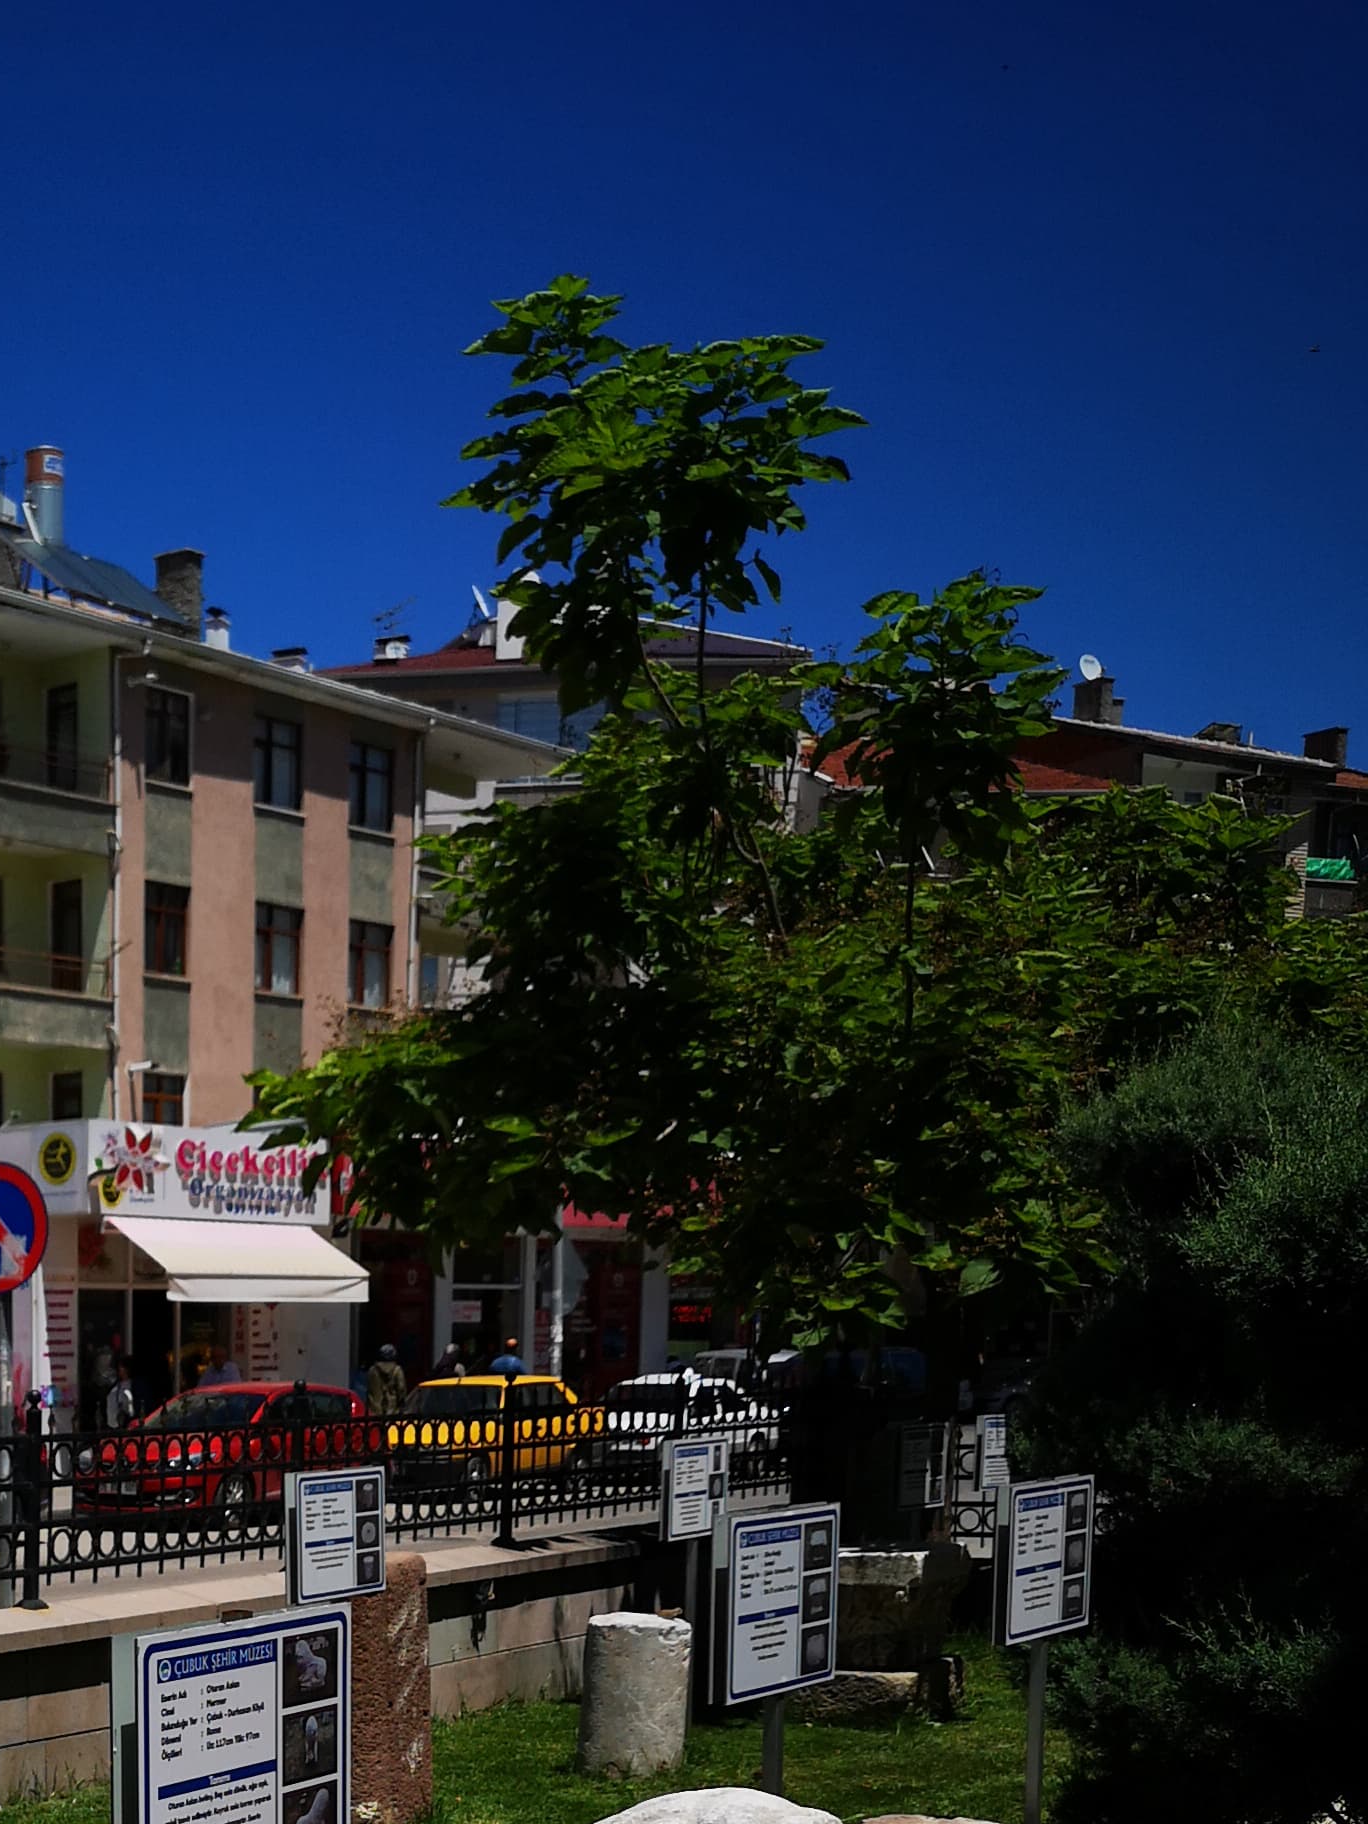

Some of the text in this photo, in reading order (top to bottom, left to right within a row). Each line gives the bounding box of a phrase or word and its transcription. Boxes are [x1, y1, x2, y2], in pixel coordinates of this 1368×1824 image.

[174, 1643, 273, 1678] ÇUBUK ŞEHİR MÜZESİ
